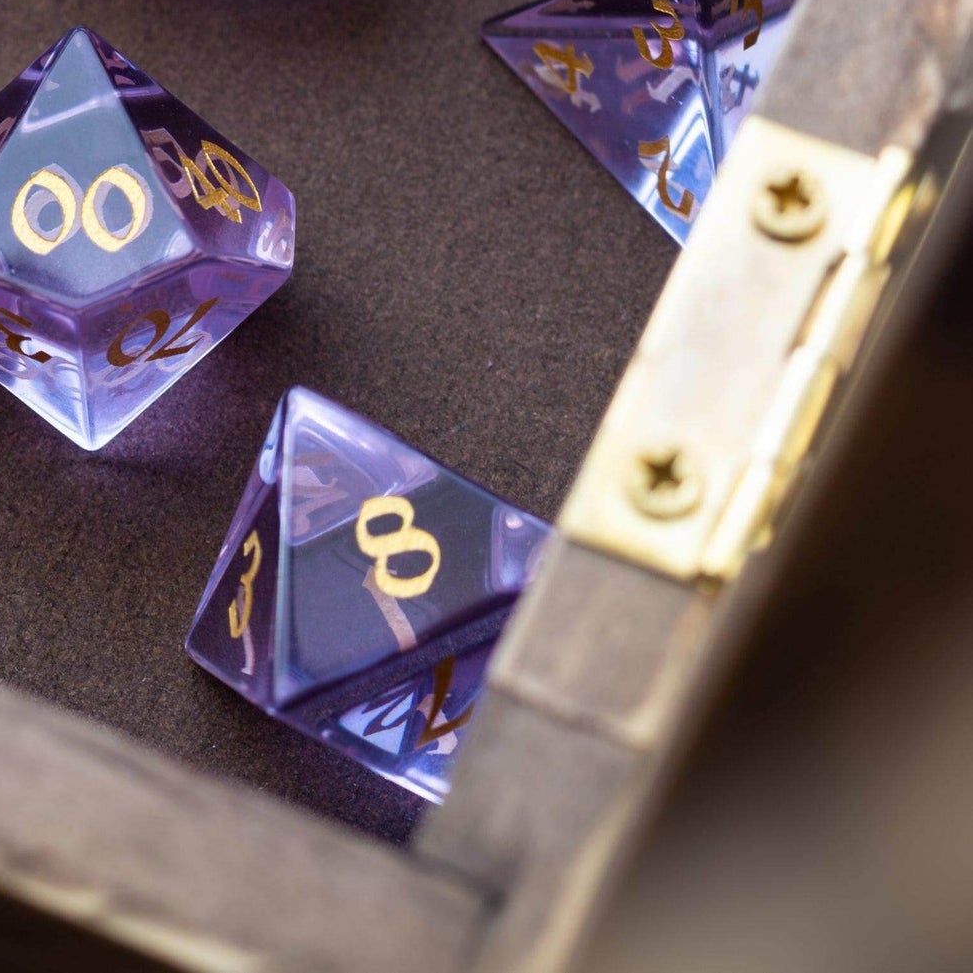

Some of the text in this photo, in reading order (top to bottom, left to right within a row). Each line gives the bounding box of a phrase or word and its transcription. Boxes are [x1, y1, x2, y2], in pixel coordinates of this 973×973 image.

[531, 40, 595, 95] 4
[10, 165, 147, 257] 00
[177, 139, 263, 225] 40
[228, 528, 263, 639] 3
[355, 494, 442, 599] 8
